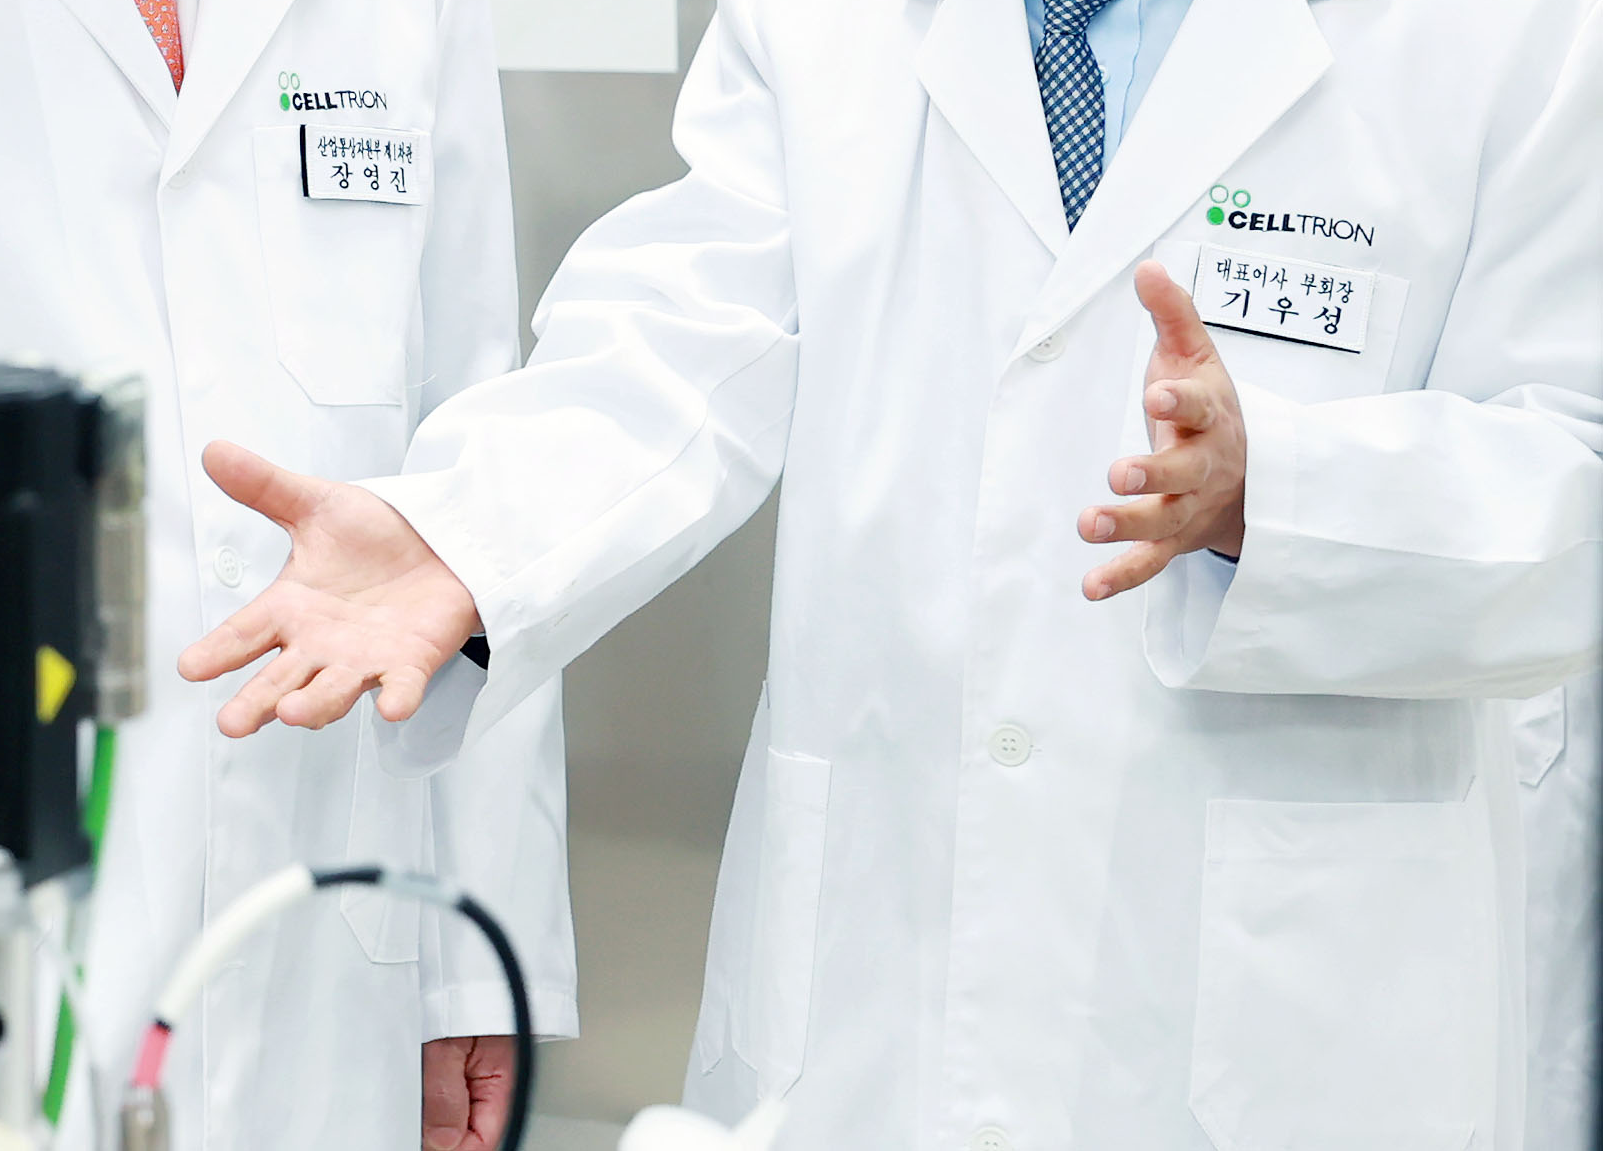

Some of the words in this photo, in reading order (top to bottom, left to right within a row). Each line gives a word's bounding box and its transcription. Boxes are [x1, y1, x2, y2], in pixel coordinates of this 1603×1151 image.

[292, 90, 387, 111] CELLTRION
[1228, 210, 1375, 247] CELLTRION
[1216, 257, 1288, 291] 대표이사
[1300, 273, 1355, 304] 부회장
